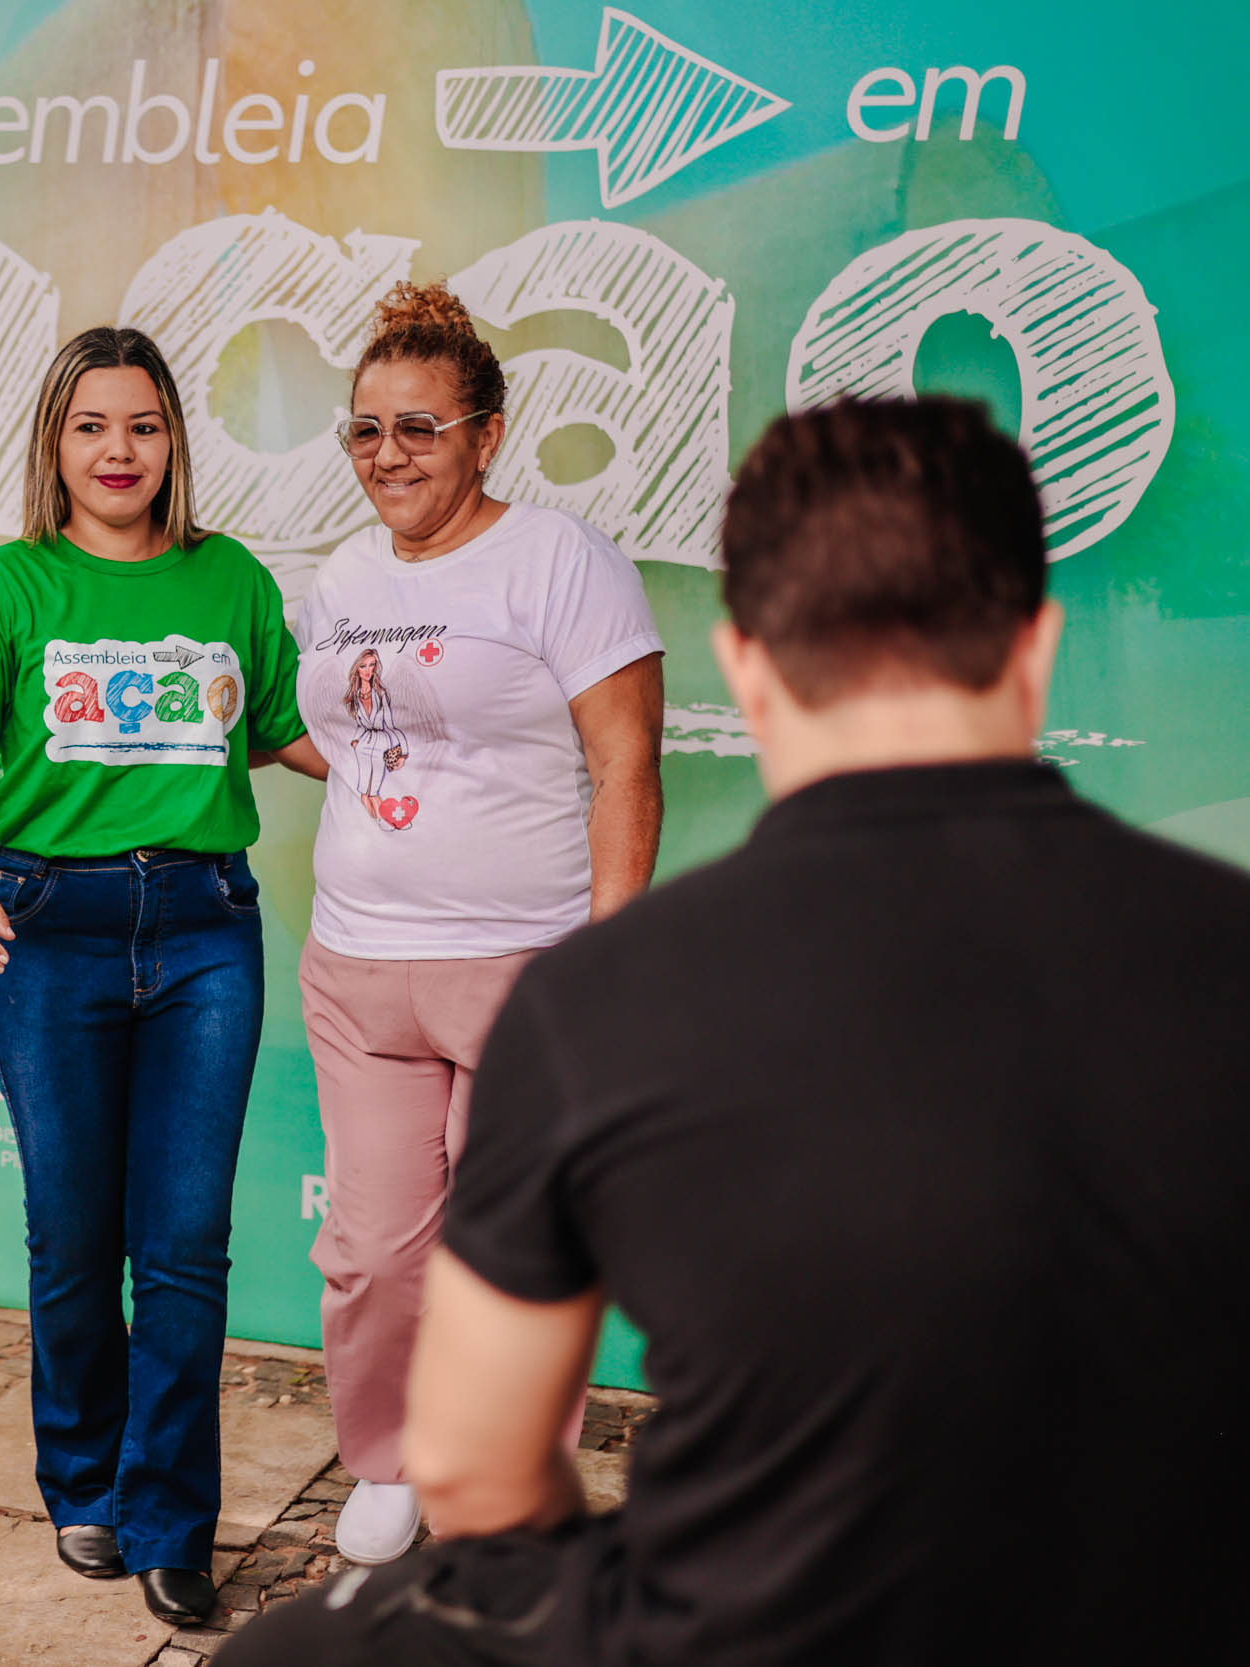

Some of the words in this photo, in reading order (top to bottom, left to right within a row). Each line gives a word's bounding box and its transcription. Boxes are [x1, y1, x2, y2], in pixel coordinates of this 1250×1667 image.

[845, 63, 1027, 142] em
[316, 618, 447, 655] Enfermagem
[54, 650, 146, 665] Assembleia
[211, 652, 231, 665] em
